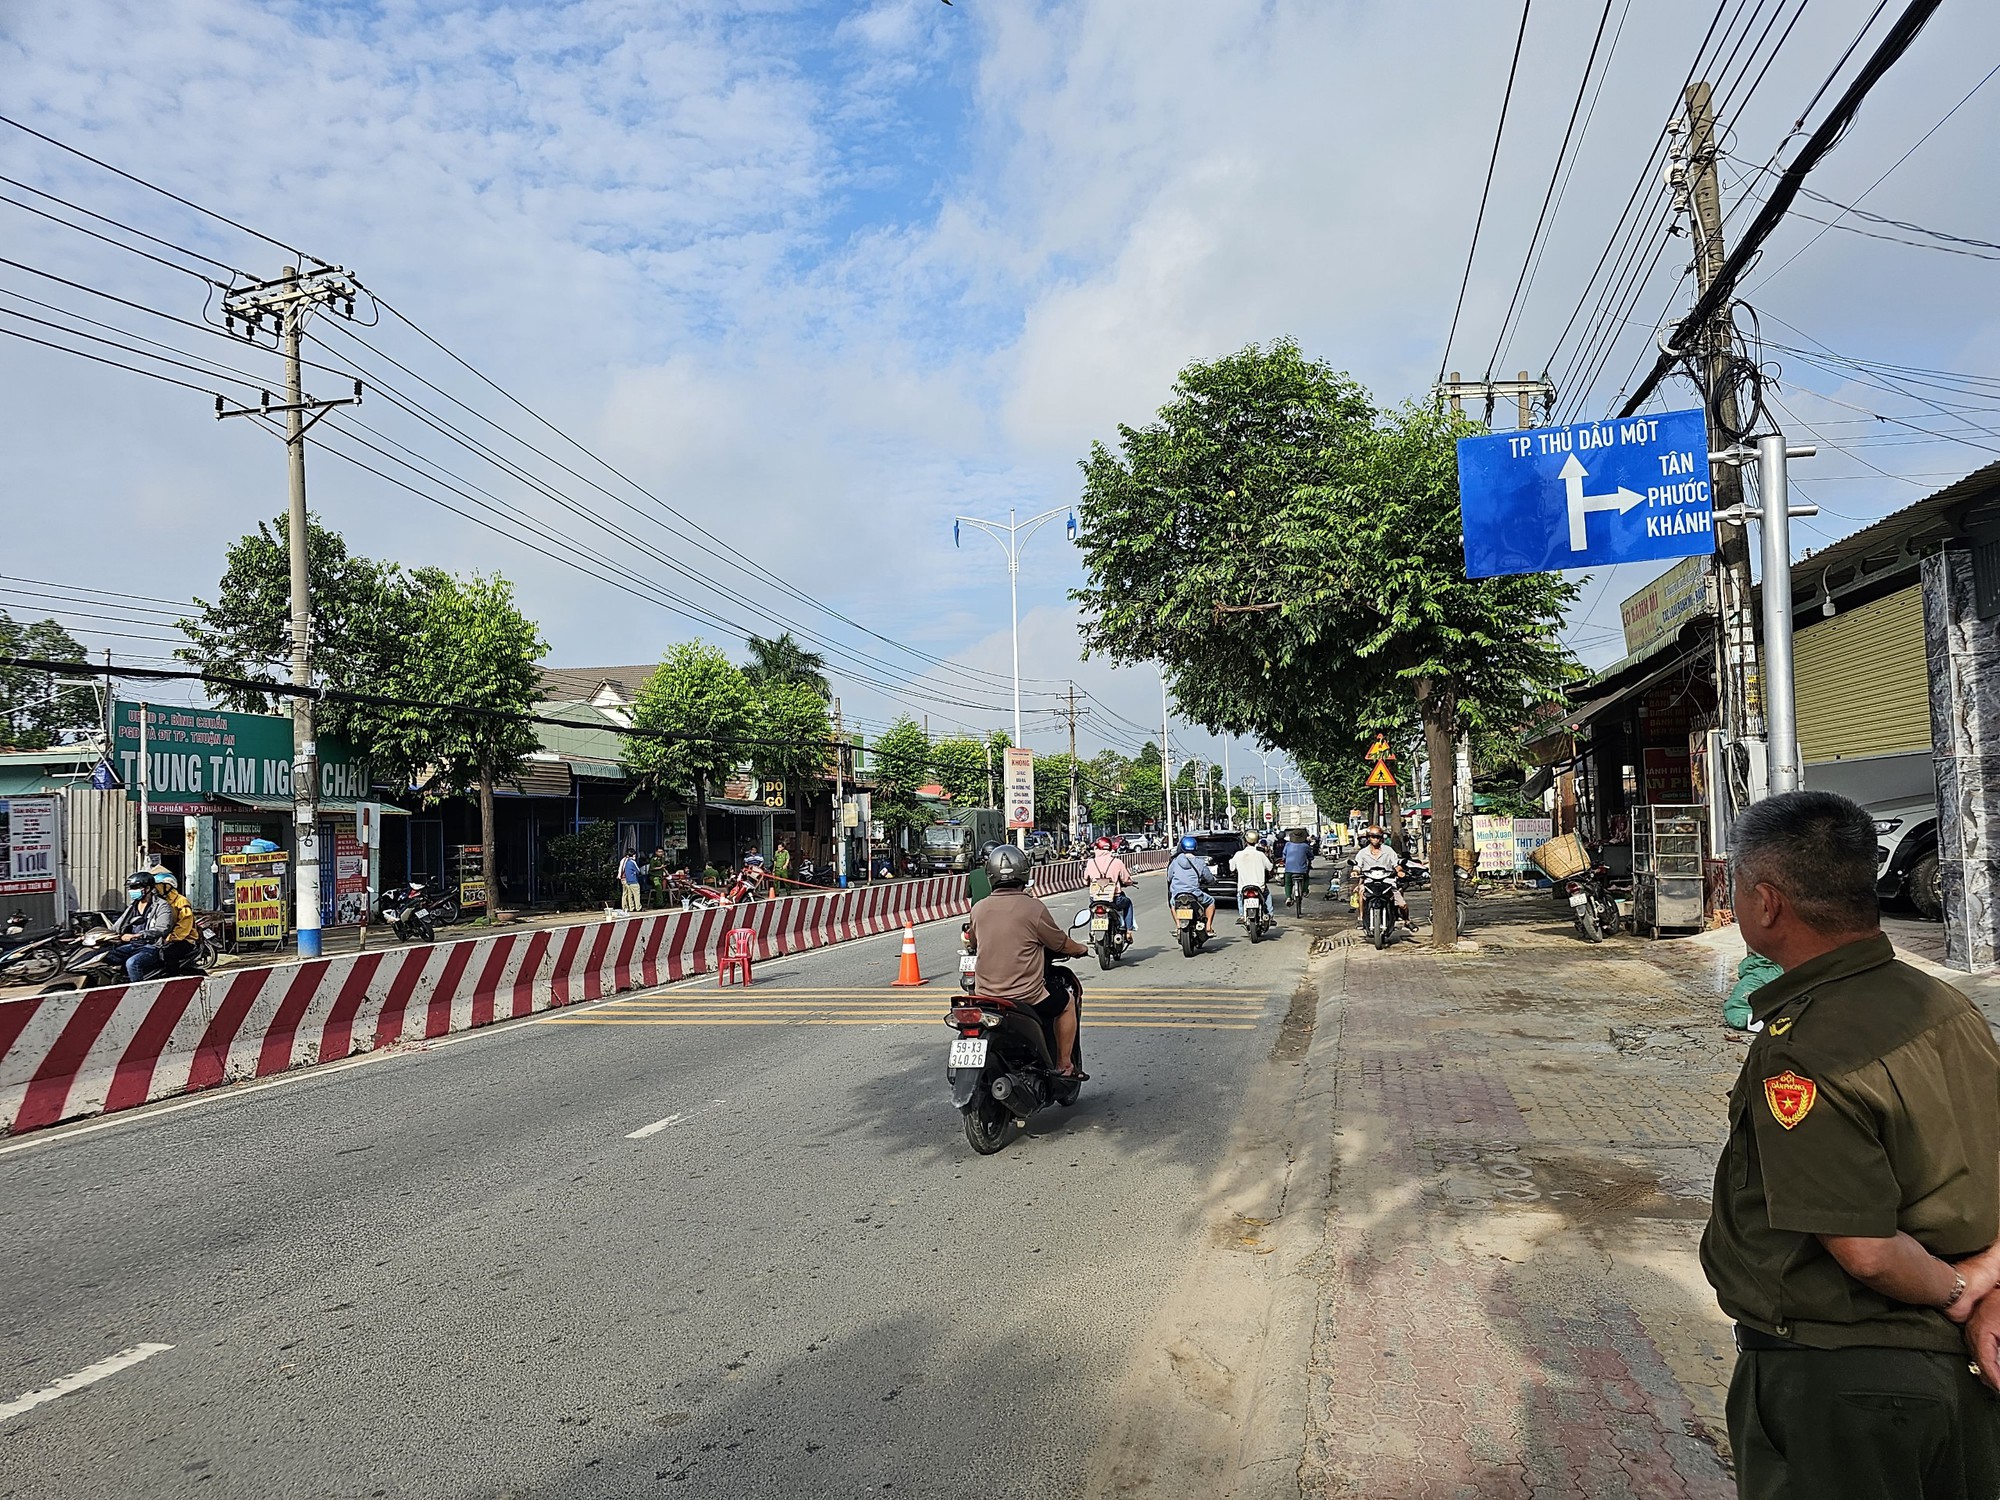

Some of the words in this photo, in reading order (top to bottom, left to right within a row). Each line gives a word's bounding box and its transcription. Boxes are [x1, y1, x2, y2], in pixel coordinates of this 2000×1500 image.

[1509, 437, 1532, 458] TP.
[1538, 425, 1572, 454] THỦ
[1580, 421, 1613, 450] DẦU
[1621, 419, 1658, 446] MỘT
[1659, 451, 1694, 476] TÂN
[1648, 478, 1709, 508] PHƯỚC
[1647, 511, 1711, 537] KHÁNH
[171, 712, 195, 727] BÌNH
[223, 735, 236, 746] AN
[121, 751, 202, 792] TRUNG
[210, 748, 256, 794] TÂM
[1516, 838, 1533, 850] THỊT
[239, 924, 261, 938] BÁNH
[264, 923, 280, 937] ƯỚT
[957, 1042, 982, 1053] 59-X3
[952, 1054, 984, 1067] 340.26
